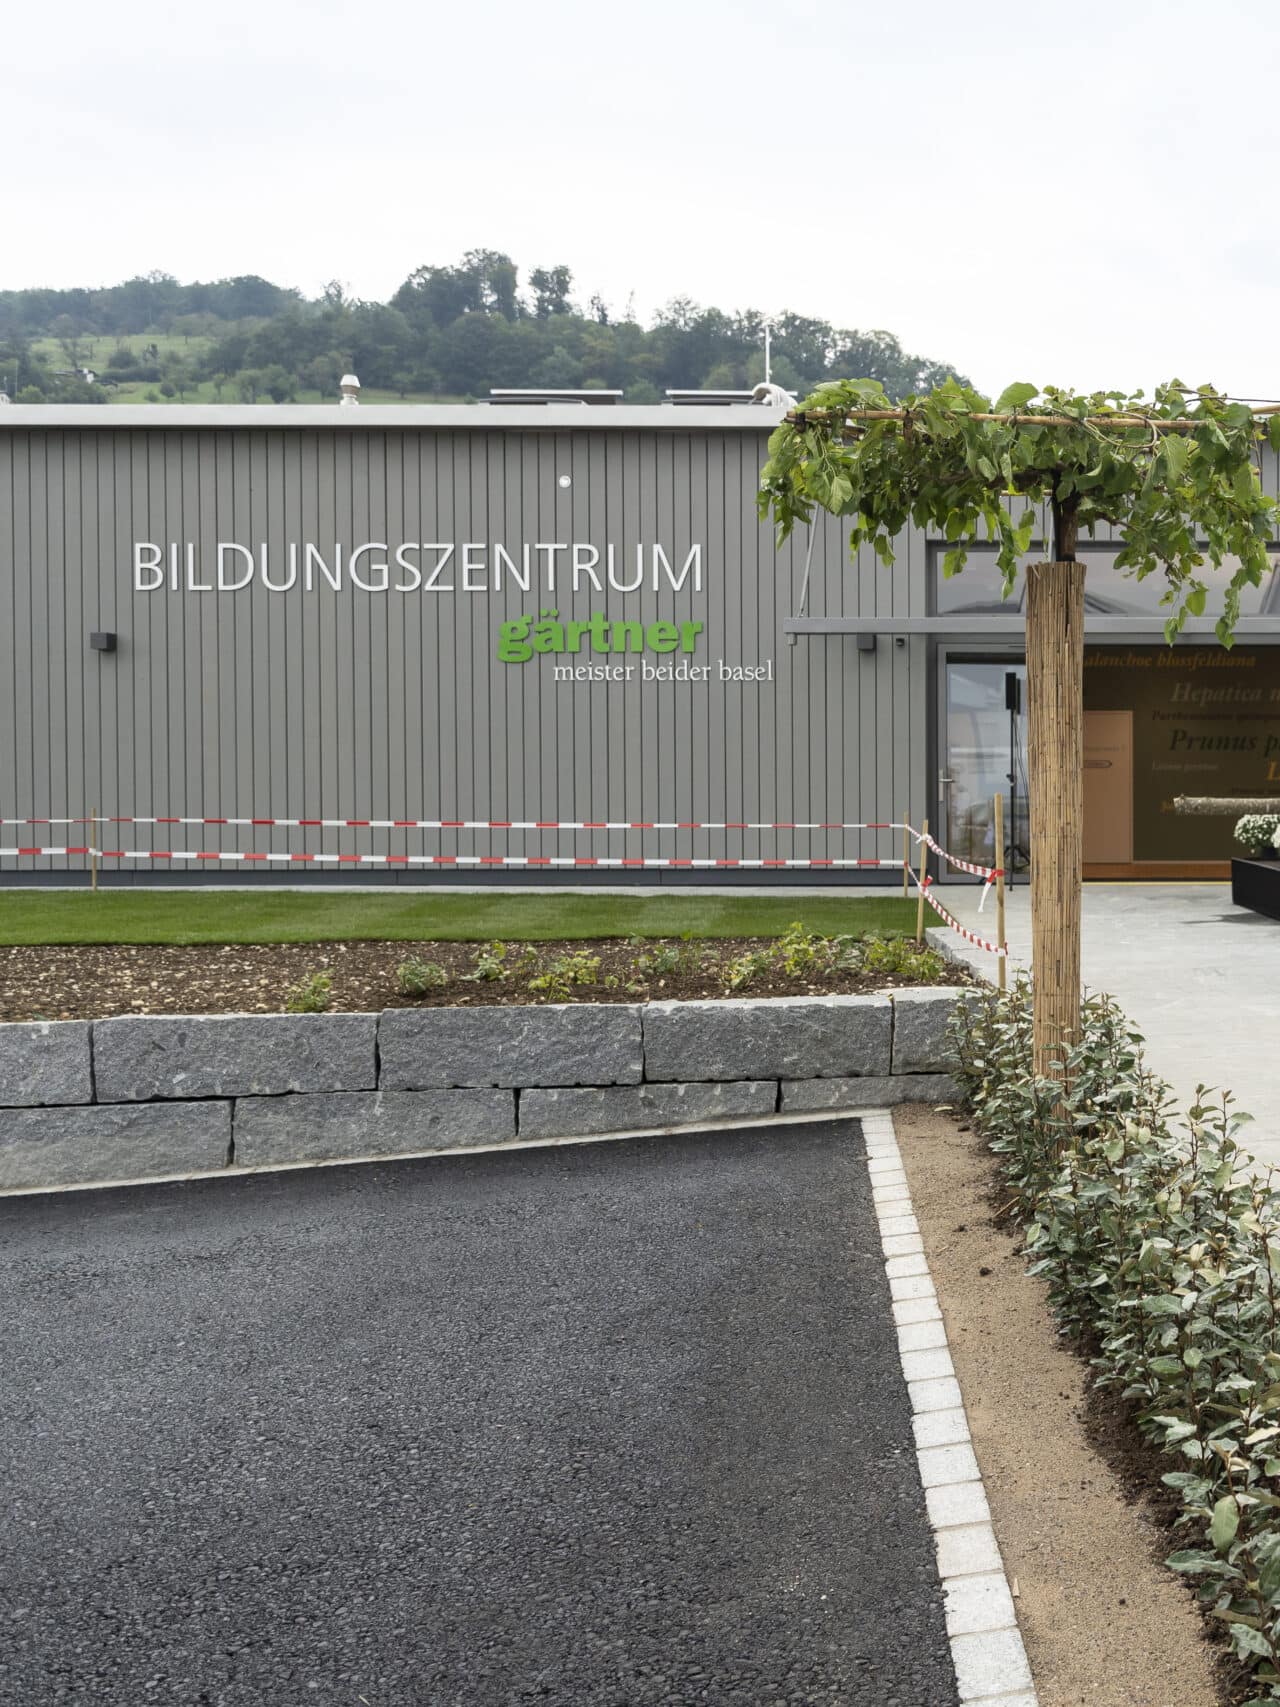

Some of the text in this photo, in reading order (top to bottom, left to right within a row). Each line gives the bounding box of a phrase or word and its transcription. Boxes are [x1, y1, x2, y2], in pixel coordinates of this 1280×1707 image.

[134, 542, 702, 592] BILDUNGSZENTRUM
[497, 608, 703, 663] gärtner
[553, 659, 774, 682] meister beider basel
[1170, 681, 1261, 706] Hepatica
[1169, 728, 1258, 751] Prunus
